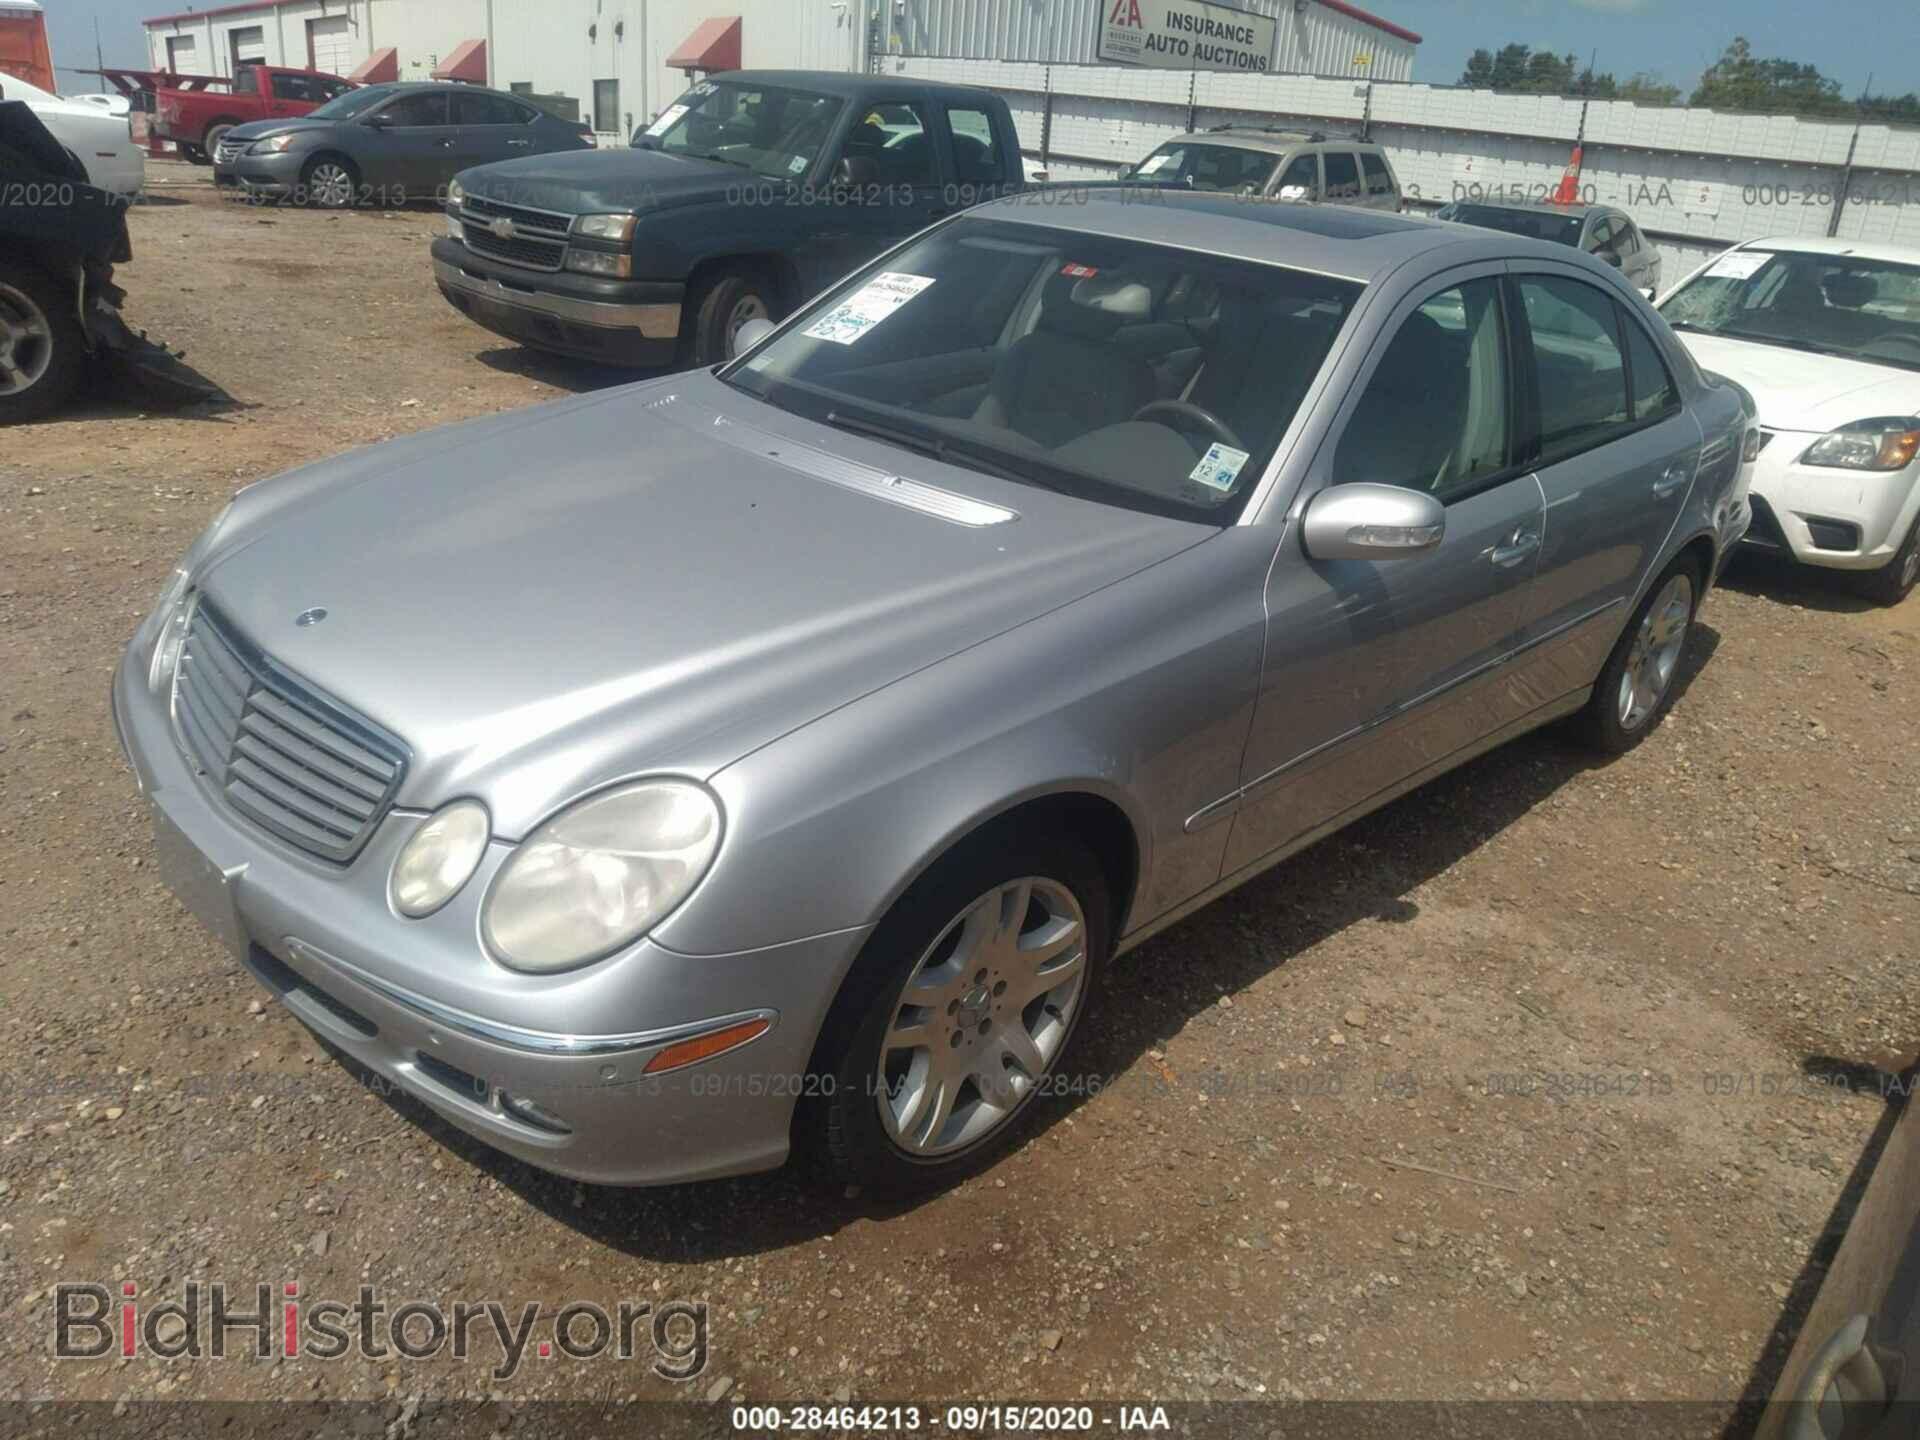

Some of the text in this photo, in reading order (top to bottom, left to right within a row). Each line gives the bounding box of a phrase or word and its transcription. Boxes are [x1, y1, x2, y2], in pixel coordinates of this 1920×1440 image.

[1166, 11, 1254, 45] INSURANCE
[1145, 33, 1189, 57] AUTO
[1193, 43, 1267, 72] AUCTIONS
[1218, 471, 1234, 485] 21
